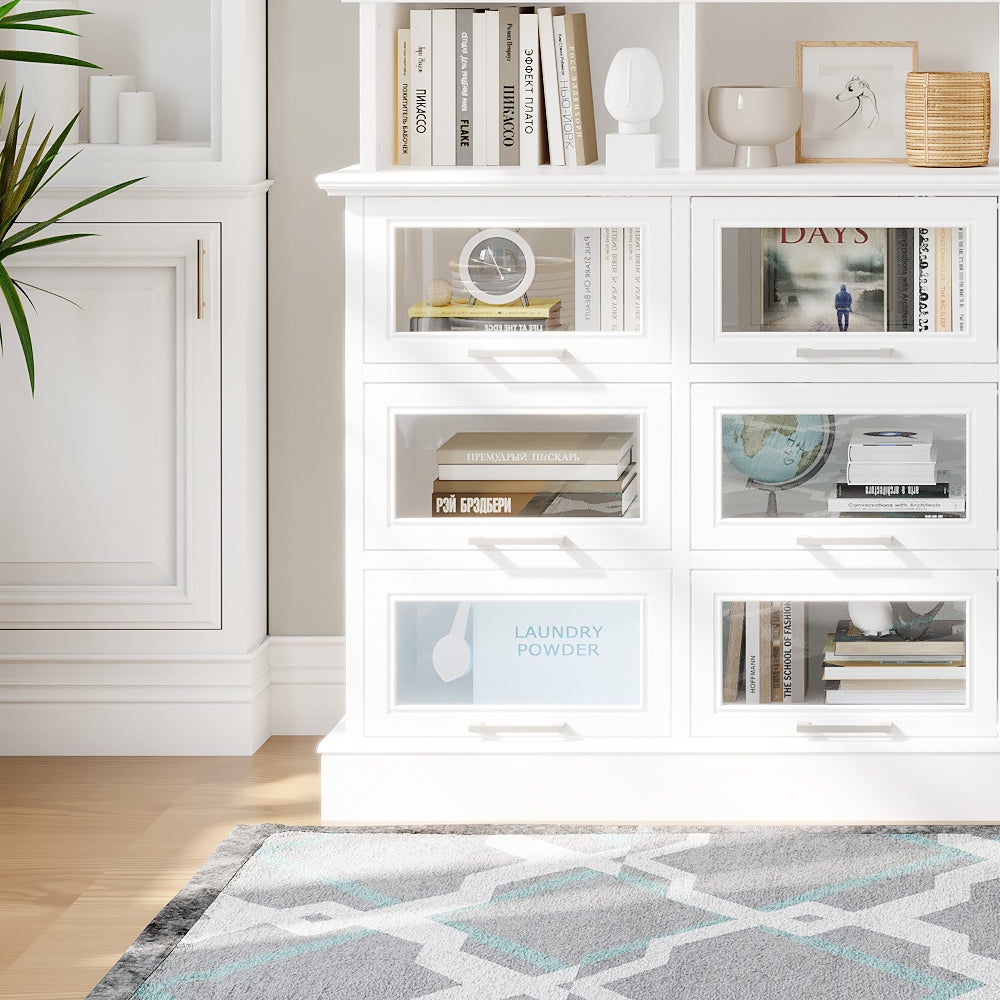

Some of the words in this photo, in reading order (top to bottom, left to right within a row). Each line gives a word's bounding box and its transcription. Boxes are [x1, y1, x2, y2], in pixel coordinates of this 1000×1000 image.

[525, 48, 534, 93] ЭФФЕКТ
[568, 46, 577, 72] РОСС
[416, 89, 427, 134] ПИКАССО
[503, 85, 515, 147] ПИКАССО
[525, 97, 534, 135] ПЛАТО
[560, 80, 575, 150] НЬЮ-ЙОРК
[460, 119, 470, 147] FLAKE
[466, 452, 527, 462] ПРЕМУДРЫЙ
[436, 494, 457, 513] РЭЙ
[460, 497, 512, 514] БРЭДБЕРИ
[515, 625, 603, 638] LAUNDRY
[783, 601, 792, 635] FASHION
[518, 643, 600, 656] POWDER
[783, 636, 792, 647] OF
[783, 648, 792, 681] SCHOOL
[783, 682, 792, 699] THE
